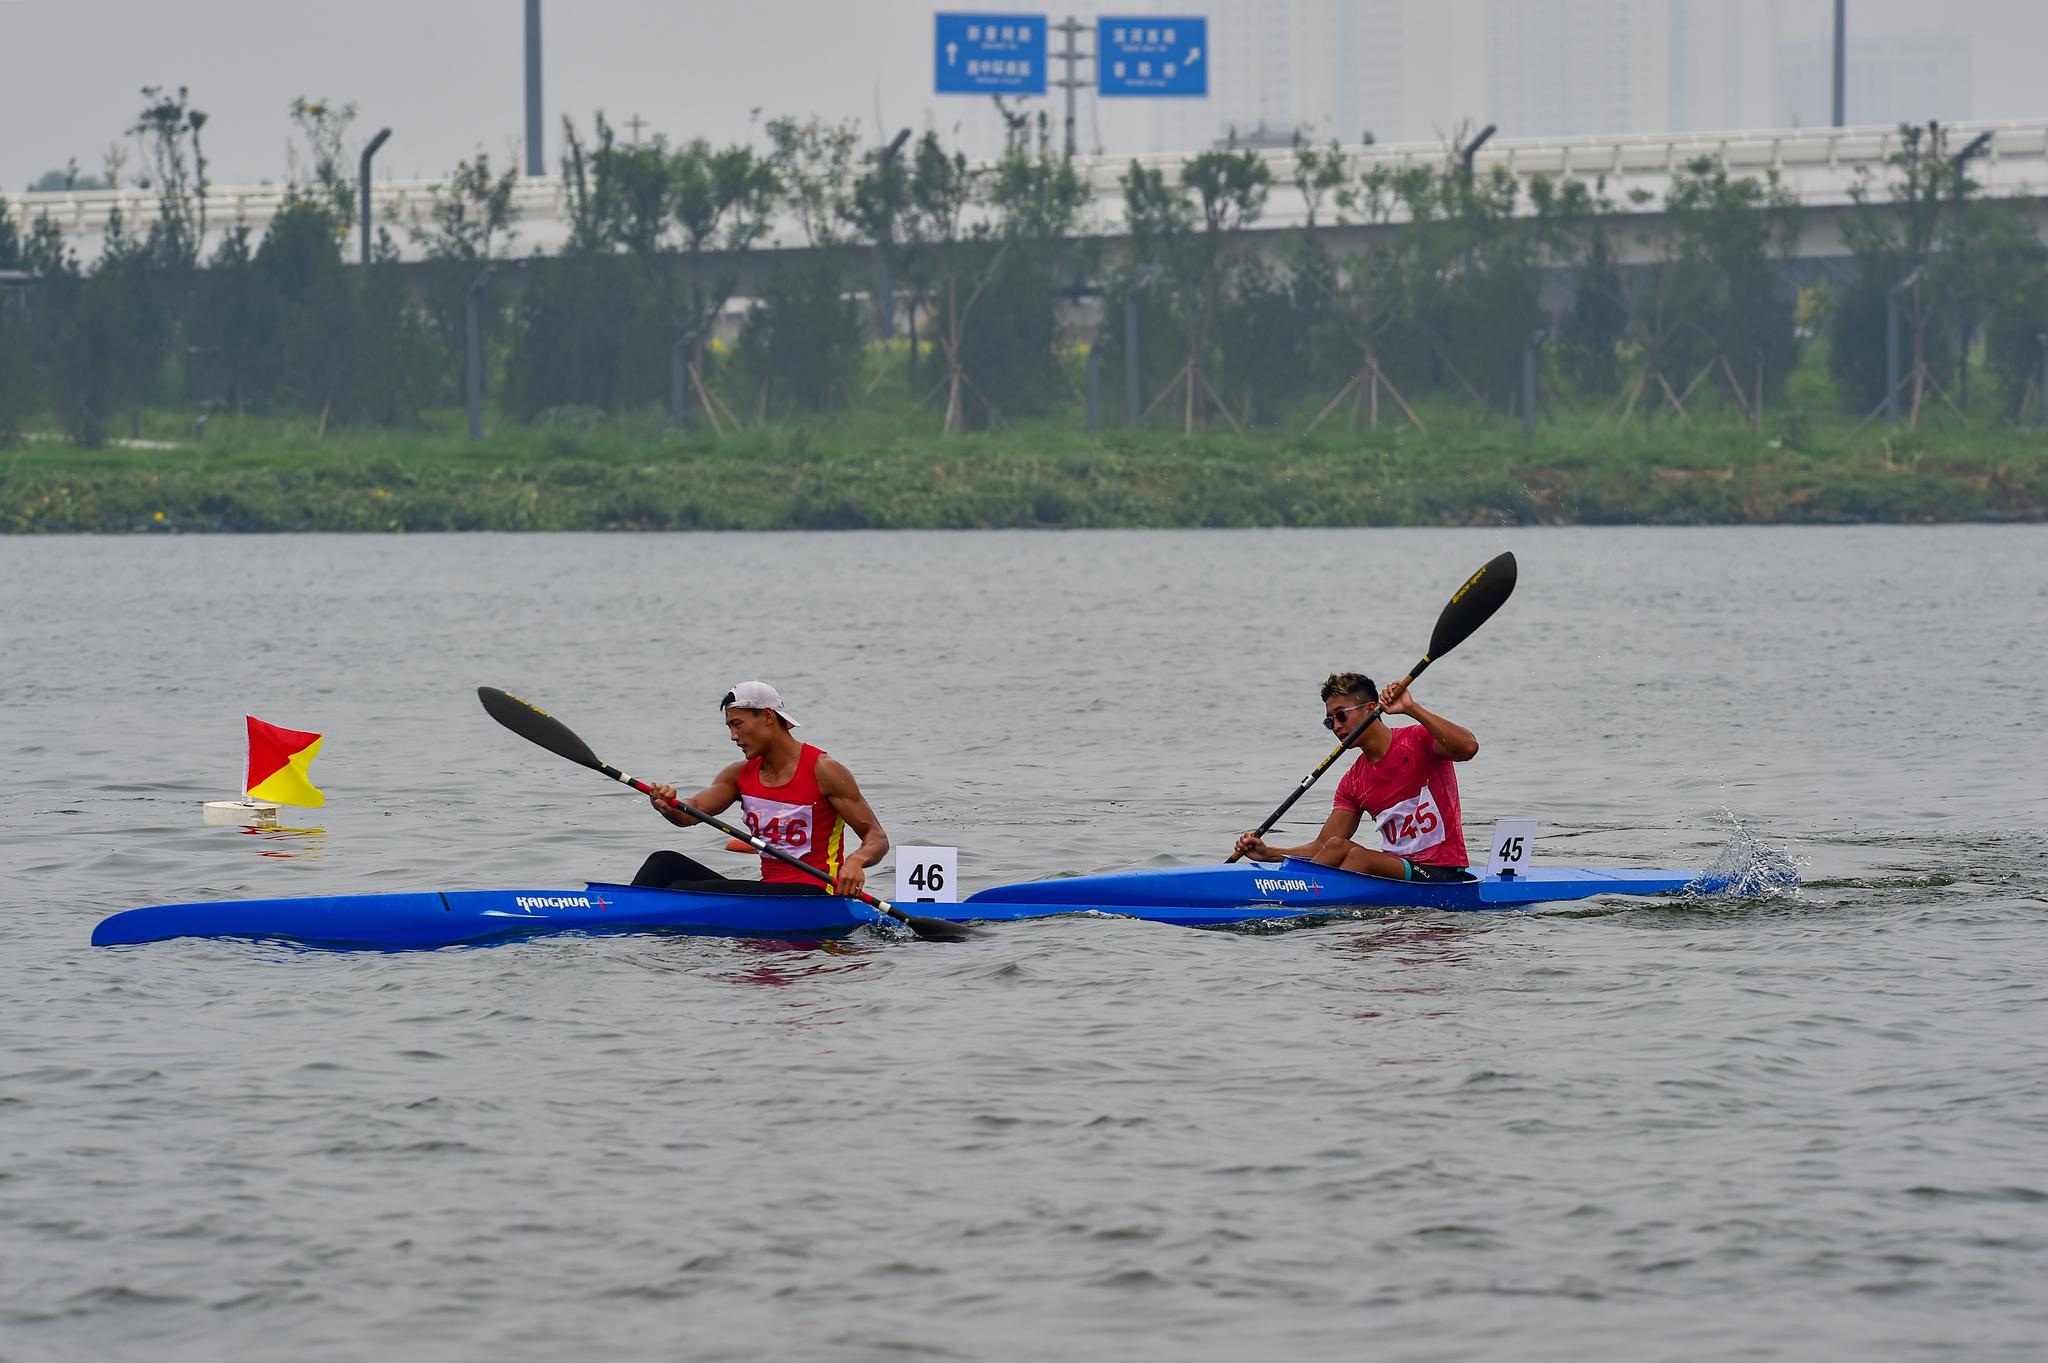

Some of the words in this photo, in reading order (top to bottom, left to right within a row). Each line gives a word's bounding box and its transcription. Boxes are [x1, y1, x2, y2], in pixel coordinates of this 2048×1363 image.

[745, 811, 808, 847] 046
[1382, 801, 1437, 844] 045
[1499, 837, 1524, 862] 45
[908, 863, 944, 891] 46
